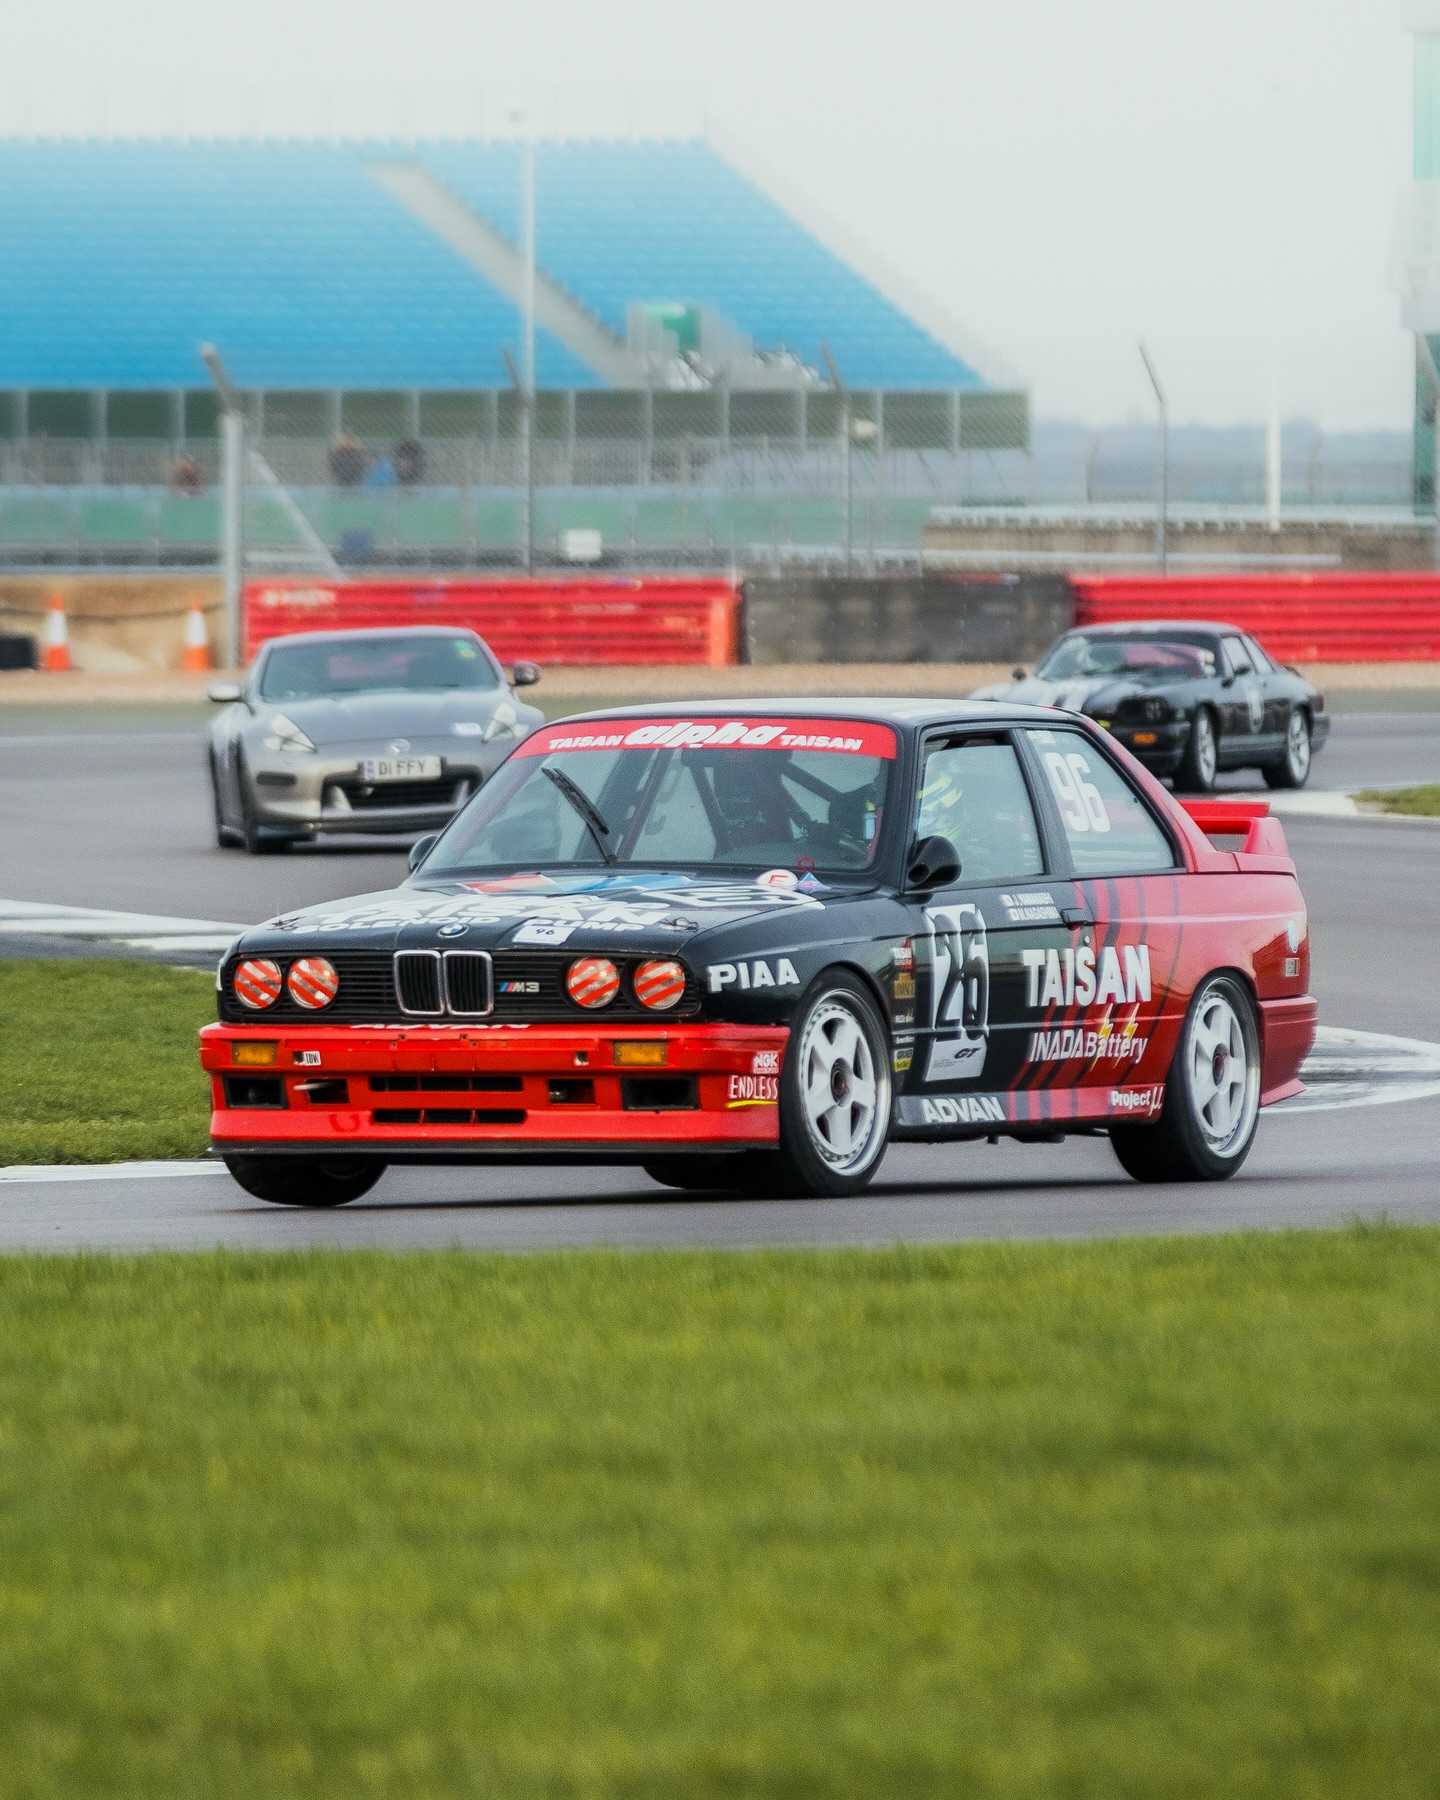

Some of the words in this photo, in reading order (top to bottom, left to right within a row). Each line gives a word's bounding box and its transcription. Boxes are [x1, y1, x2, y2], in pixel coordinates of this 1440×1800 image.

[550, 734, 624, 750] TAISAN
[623, 722, 788, 748] alpha
[780, 734, 863, 751] TAISAN
[1045, 752, 1111, 832] 96
[291, 916, 501, 934] SOLENOID
[524, 919, 645, 932] PUMP
[535, 928, 556, 938] 96
[510, 981, 540, 993] M3
[707, 958, 801, 992] PIAA
[934, 910, 987, 1042] 26
[1021, 945, 1152, 1007] TAISAN
[753, 1053, 779, 1068] NGK
[954, 1047, 983, 1059] GT
[728, 1075, 779, 1100] ENDLESS
[922, 1096, 1007, 1123] ADVAN
[1111, 1090, 1150, 1111] Project
